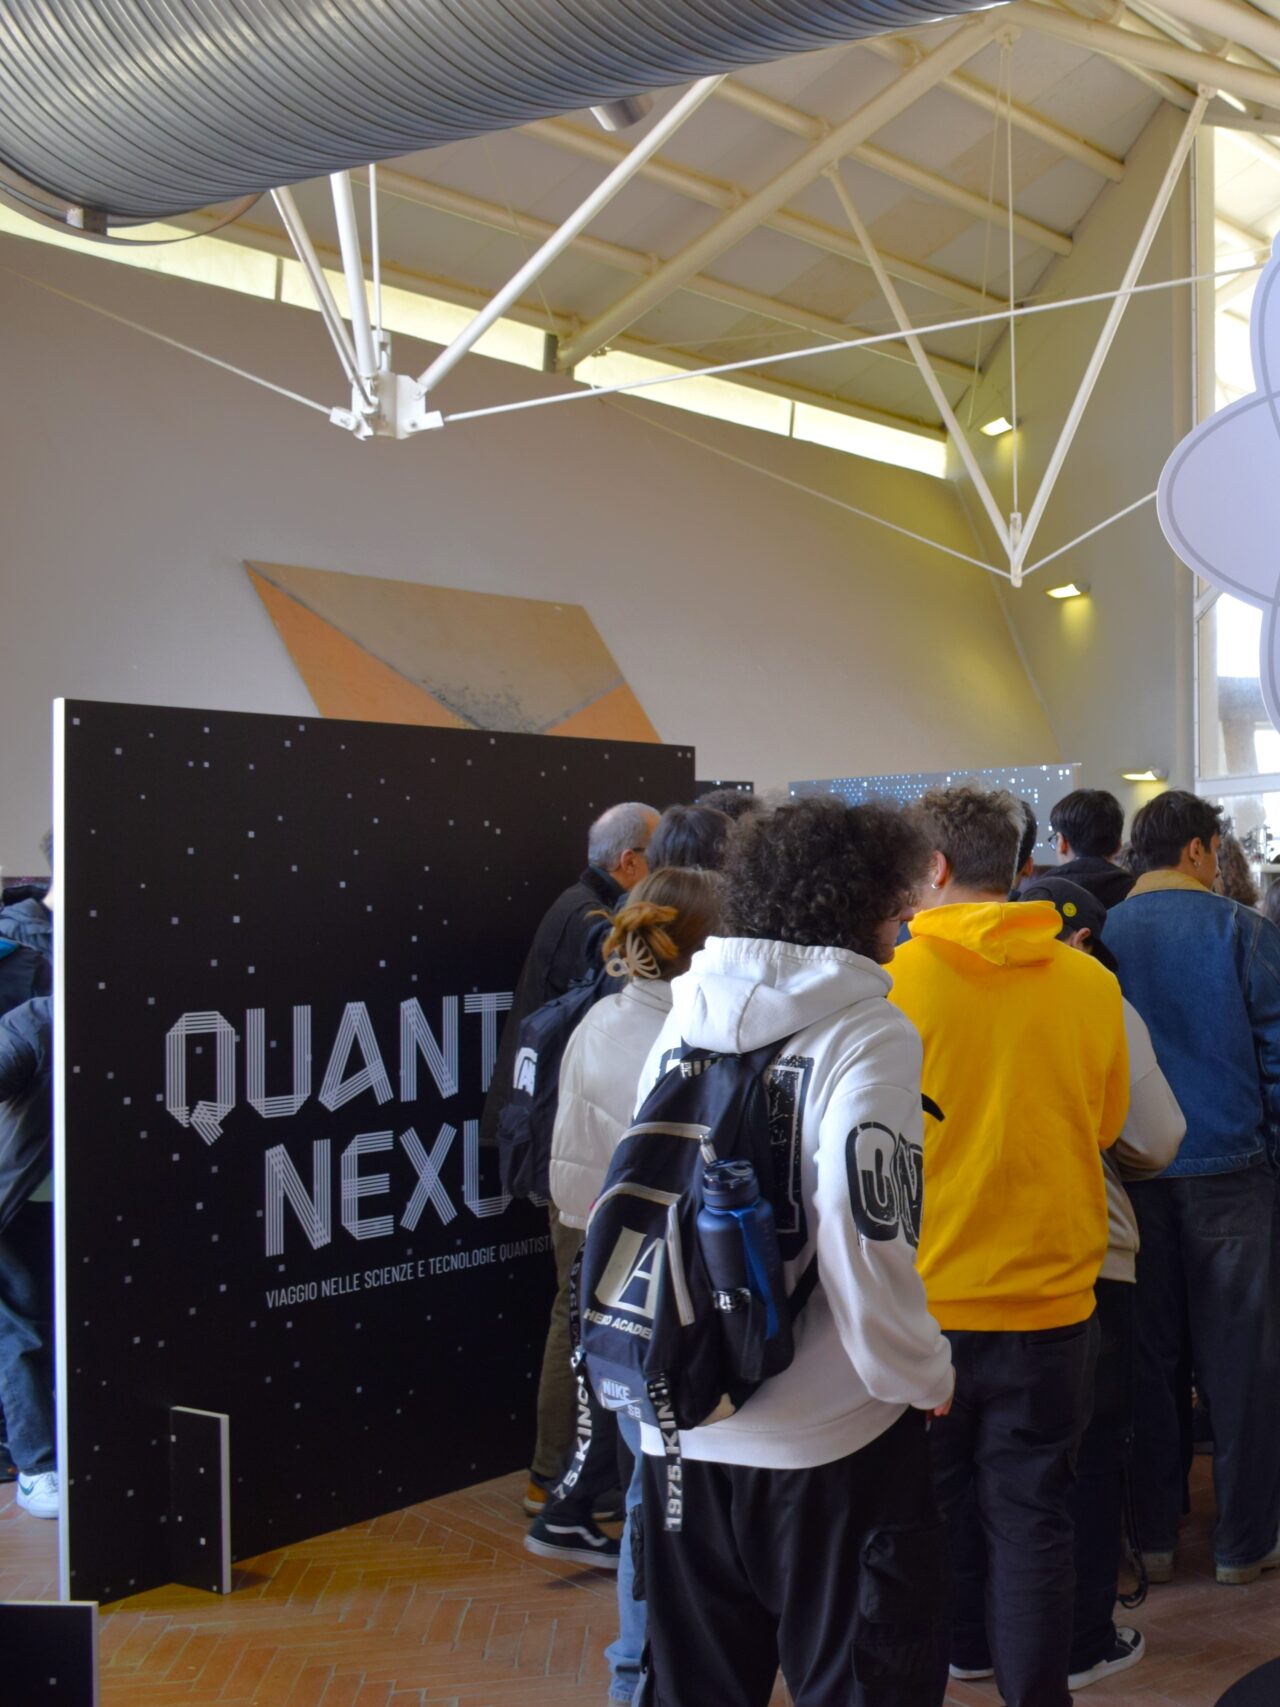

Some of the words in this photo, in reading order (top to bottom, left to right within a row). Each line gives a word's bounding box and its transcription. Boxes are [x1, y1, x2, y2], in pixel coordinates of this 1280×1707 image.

[166, 991, 514, 1146] QUANT
[265, 1119, 548, 1257] NEXU
[266, 1282, 318, 1308] VIAGGIO
[321, 1273, 361, 1298] NELLE
[364, 1264, 415, 1289] SCIENZE
[418, 1260, 425, 1278] E
[429, 1246, 497, 1275] TECNOLOGIE
[602, 1379, 631, 1401] NIKE
[627, 1404, 642, 1419] SB
